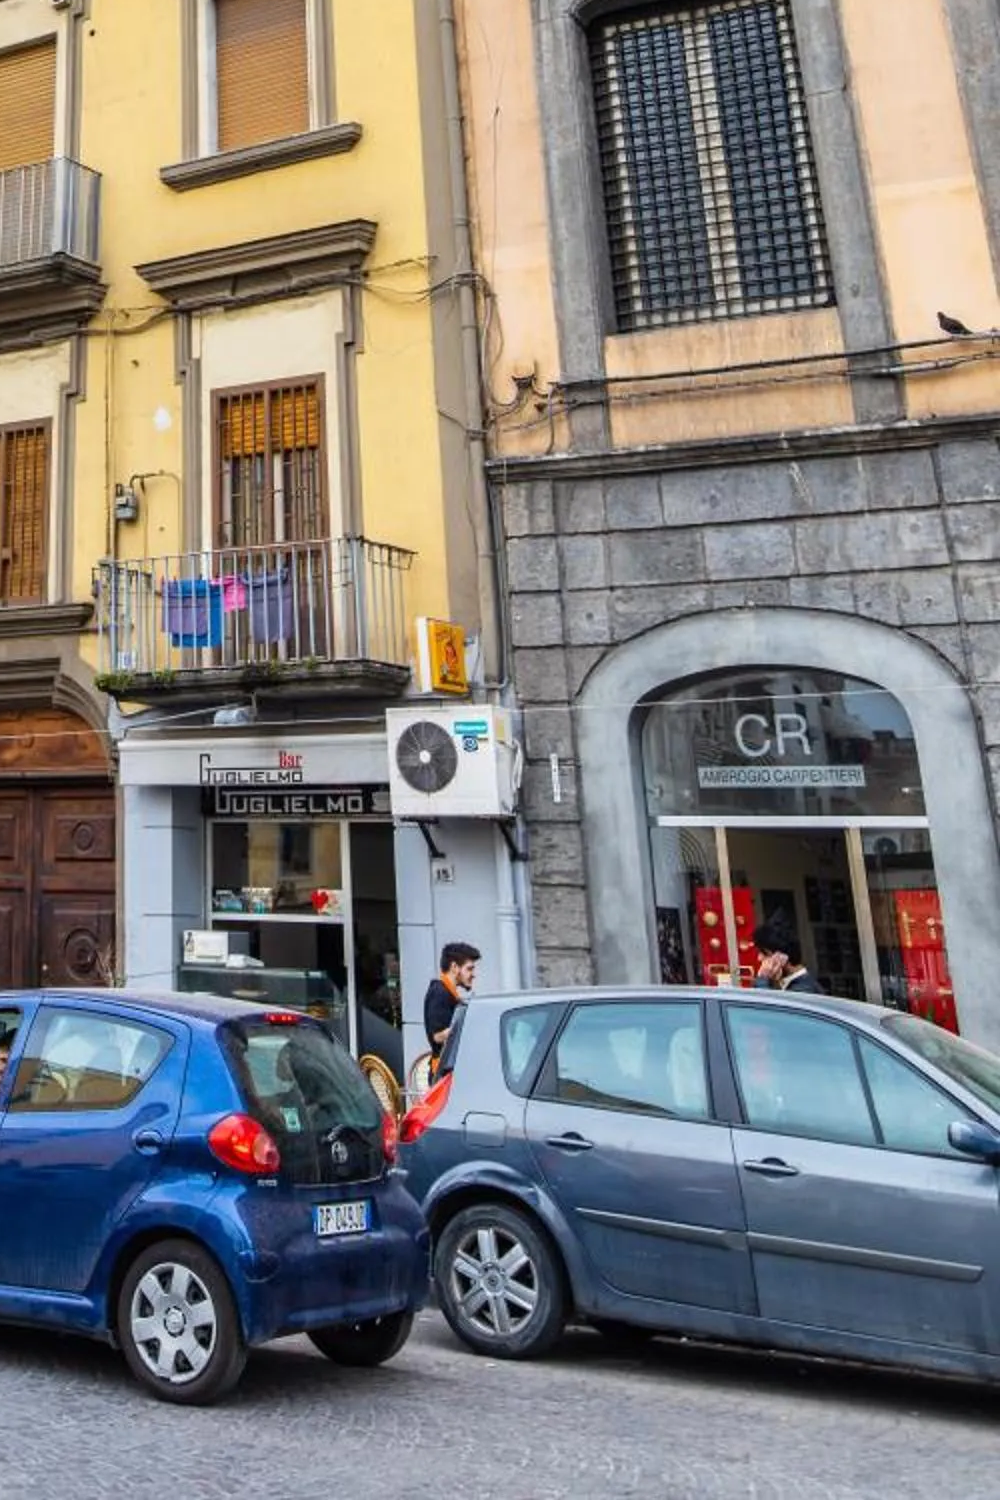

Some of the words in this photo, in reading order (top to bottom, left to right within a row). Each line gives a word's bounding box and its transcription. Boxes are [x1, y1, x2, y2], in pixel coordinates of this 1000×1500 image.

[735, 713, 812, 757] CR
[200, 754, 304, 784] GUGLIELMO
[702, 768, 771, 784] AMBROGIO
[774, 768, 863, 784] CARPENTIERI
